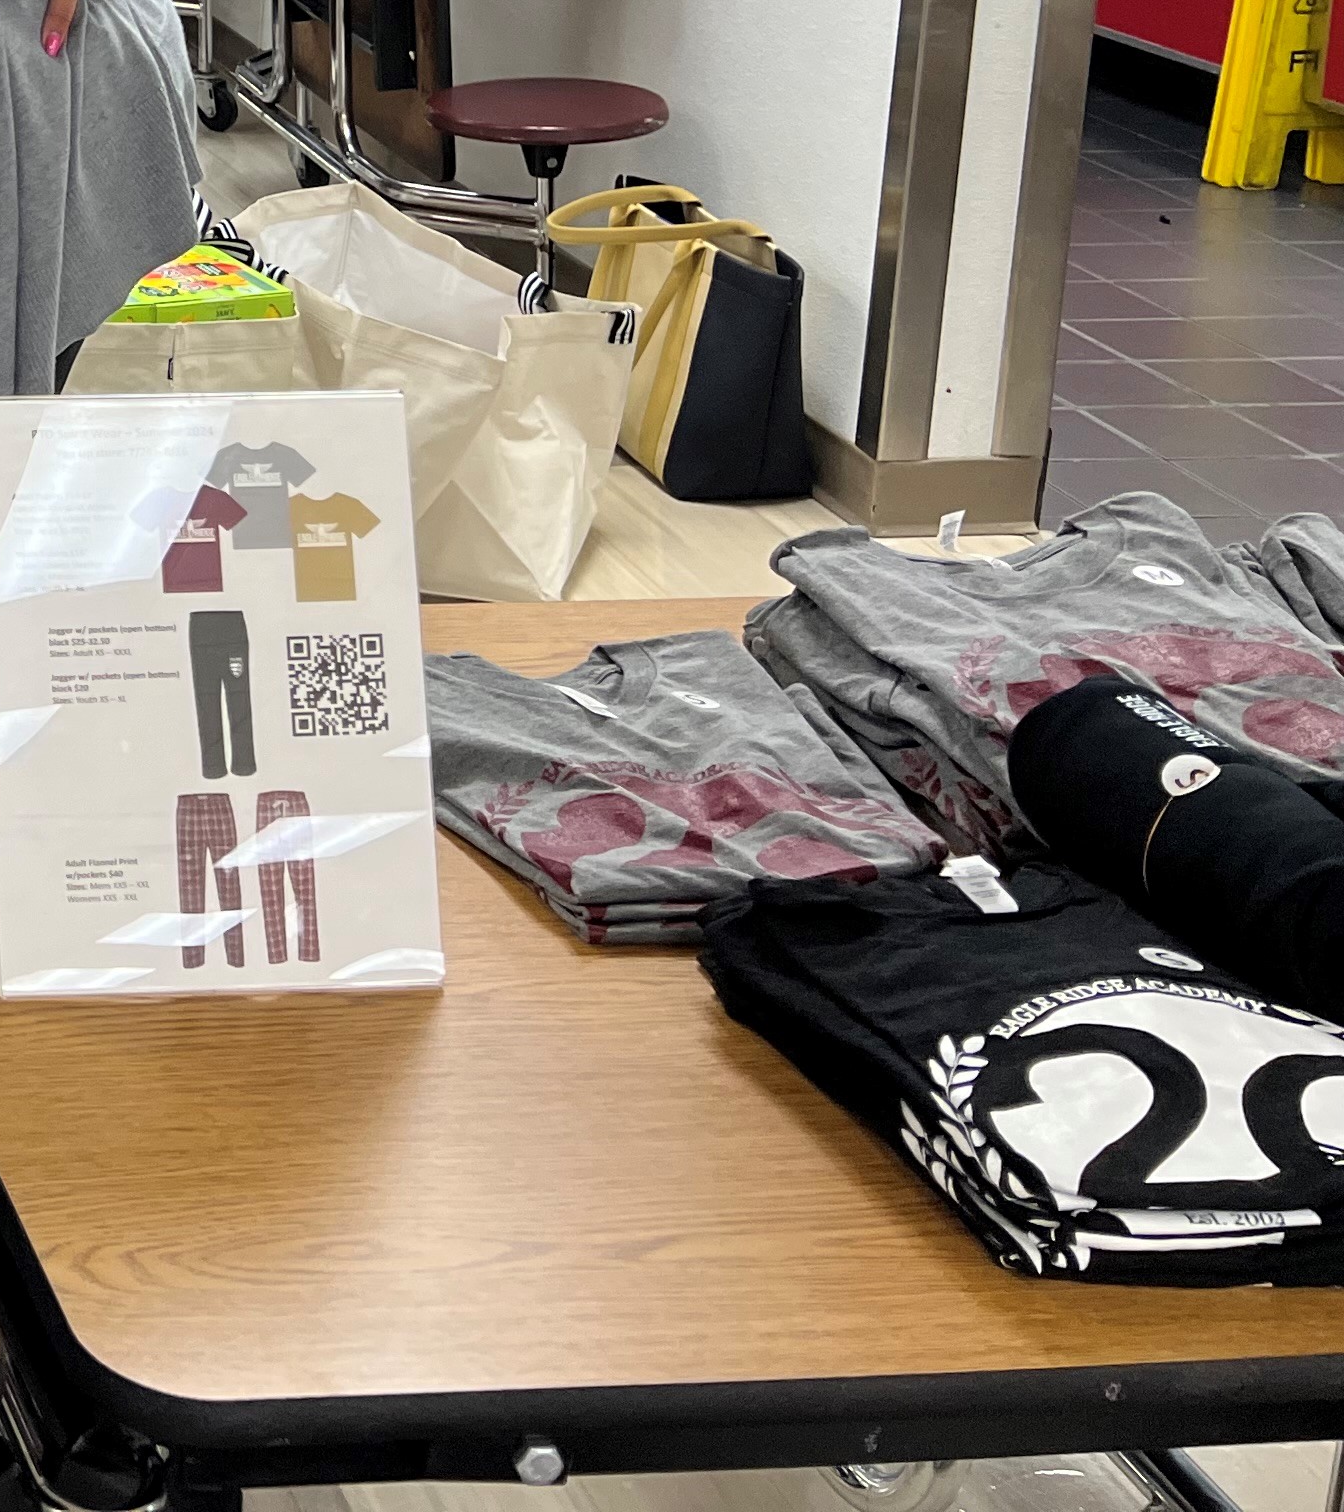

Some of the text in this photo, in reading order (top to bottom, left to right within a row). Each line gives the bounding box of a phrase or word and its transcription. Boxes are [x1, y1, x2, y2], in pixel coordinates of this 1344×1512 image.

[48, 627, 73, 636] Jogger
[88, 626, 119, 635] pockets
[48, 638, 69, 647] black
[72, 649, 93, 658] Adult
[51, 674, 76, 683] Jogger
[91, 673, 121, 681] pockets
[52, 684, 72, 693] black
[1156, 719, 1220, 748] EAGLE
[65, 859, 86, 867] Adult
[119, 857, 138, 865] Print
[989, 976, 1268, 1040] EAGLE RIDGE ACADEMY
[1183, 1210, 1287, 1229] Est. 2004
